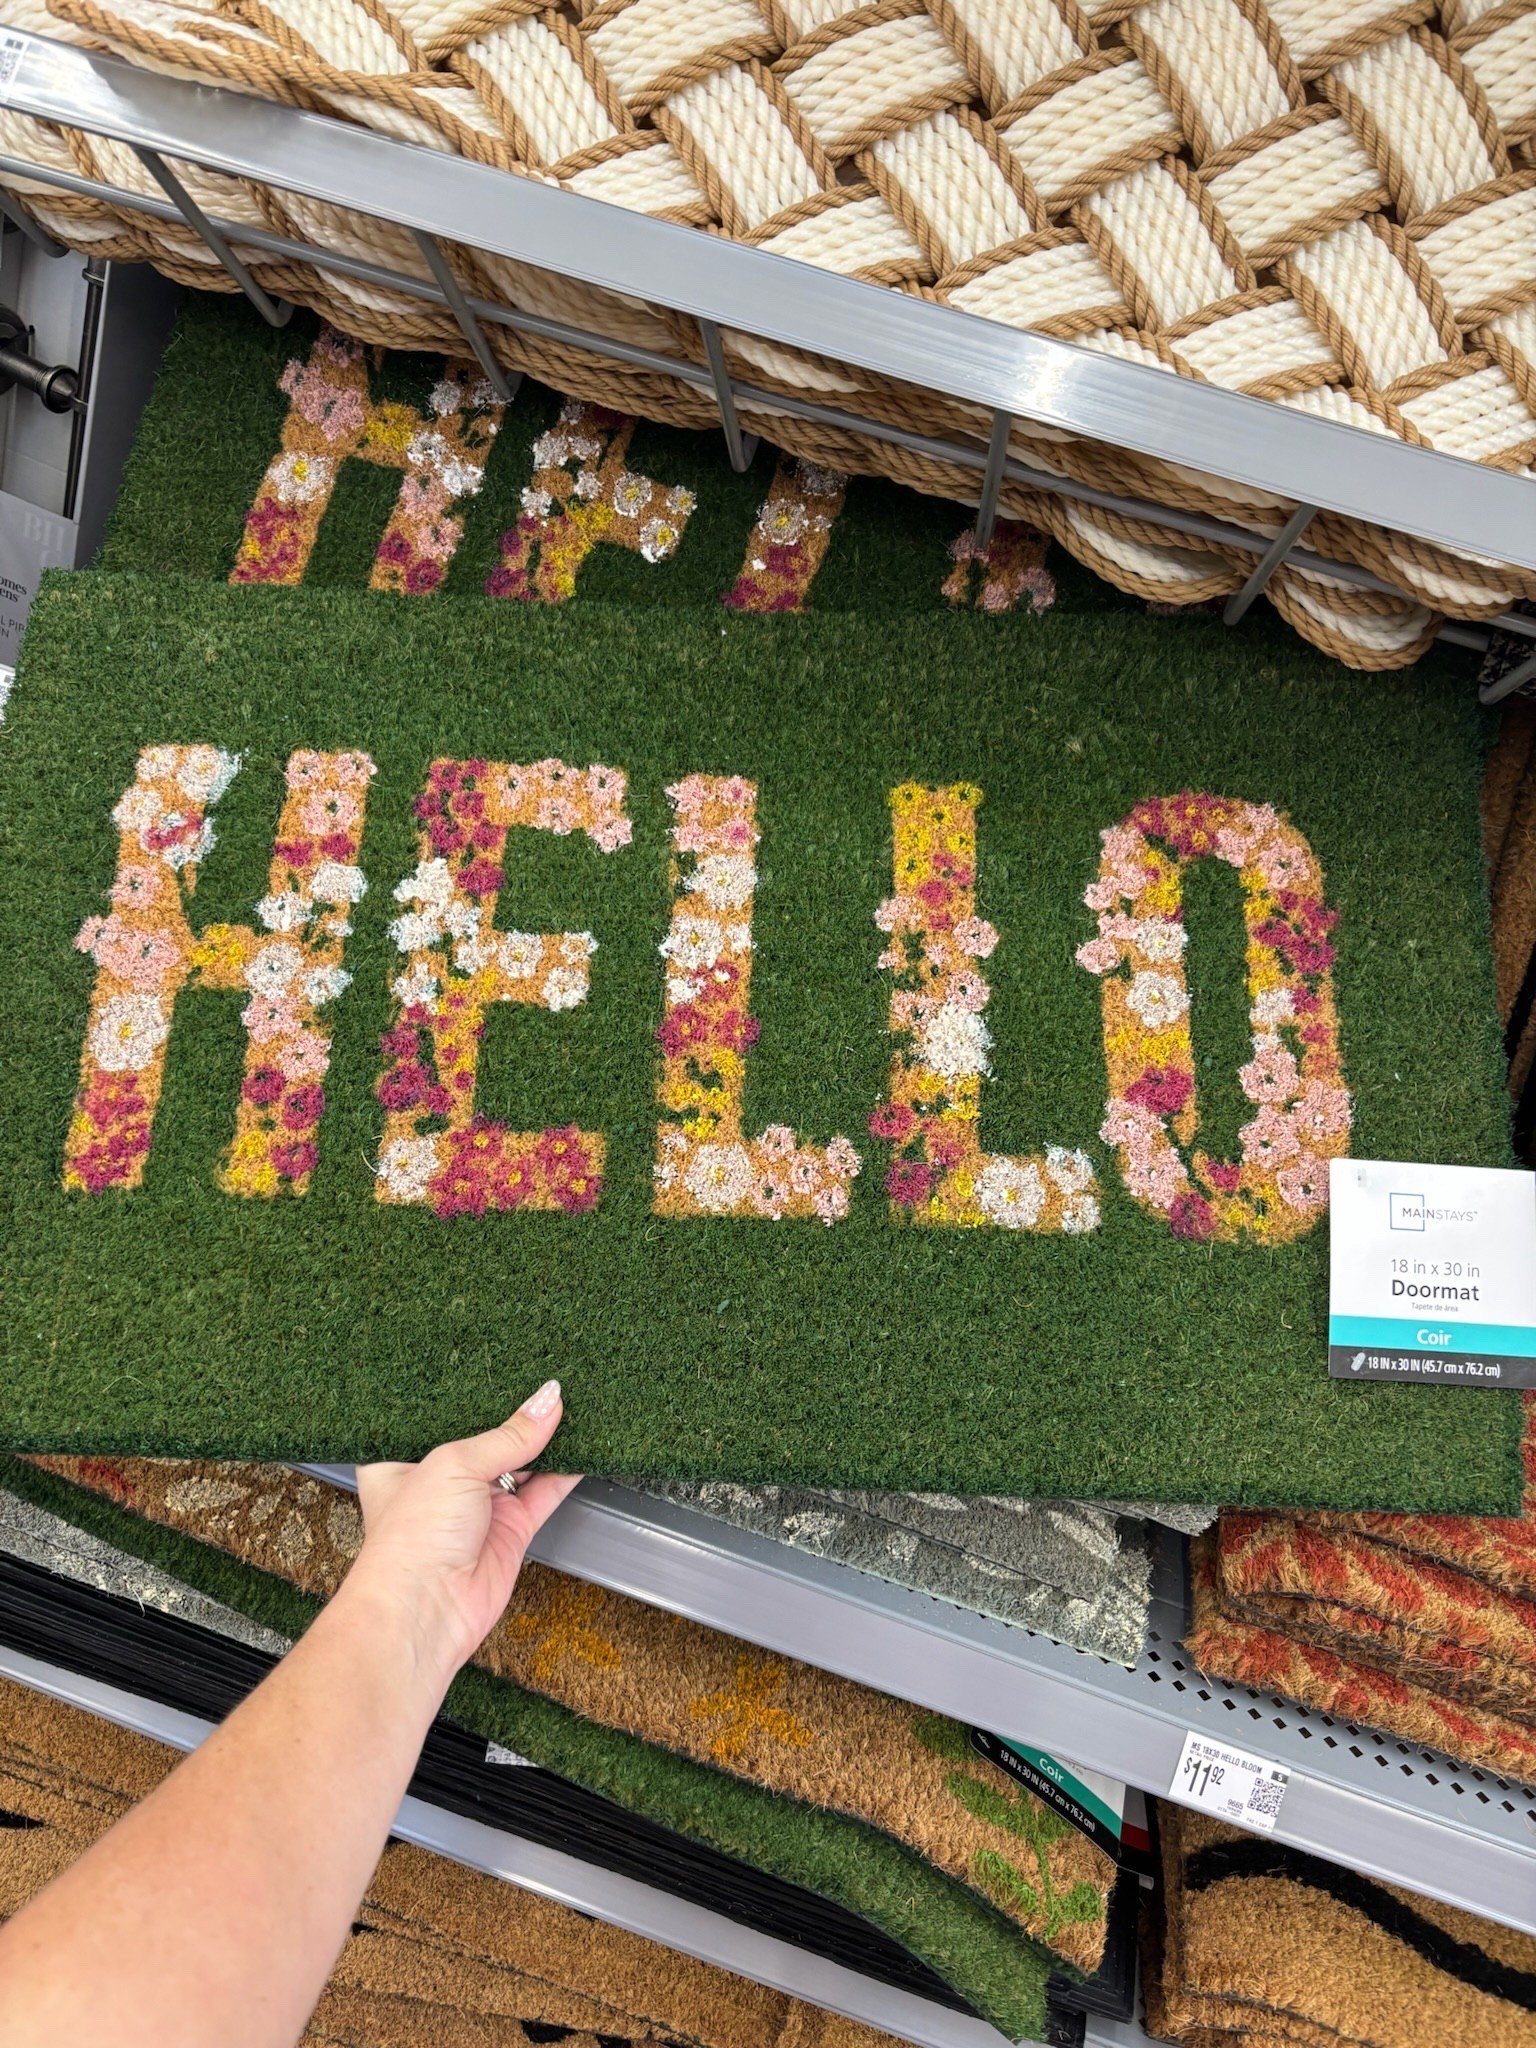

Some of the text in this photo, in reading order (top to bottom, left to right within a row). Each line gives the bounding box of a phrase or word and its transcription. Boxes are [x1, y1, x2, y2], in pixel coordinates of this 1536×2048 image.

[63, 743, 1354, 1247] HELLO
[1391, 1258, 1480, 1278] 18 in x 30 in
[1392, 1279, 1480, 1301] Doormat
[1411, 1302, 1433, 1312] Tapete
[1434, 1303, 1443, 1311] de
[1417, 1329, 1452, 1346] Coir
[1368, 1356, 1500, 1379] 18 IN x 30 IN (45.7 cm x 76.2 cm)
[1191, 1741, 1263, 1774] MS 18X30 HELLO BLOOM
[1039, 1757, 1065, 1782] Coir
[1000, 1749, 1095, 1832] 18 IN x 30 IN (45.7 cm x 76.2 cm)
